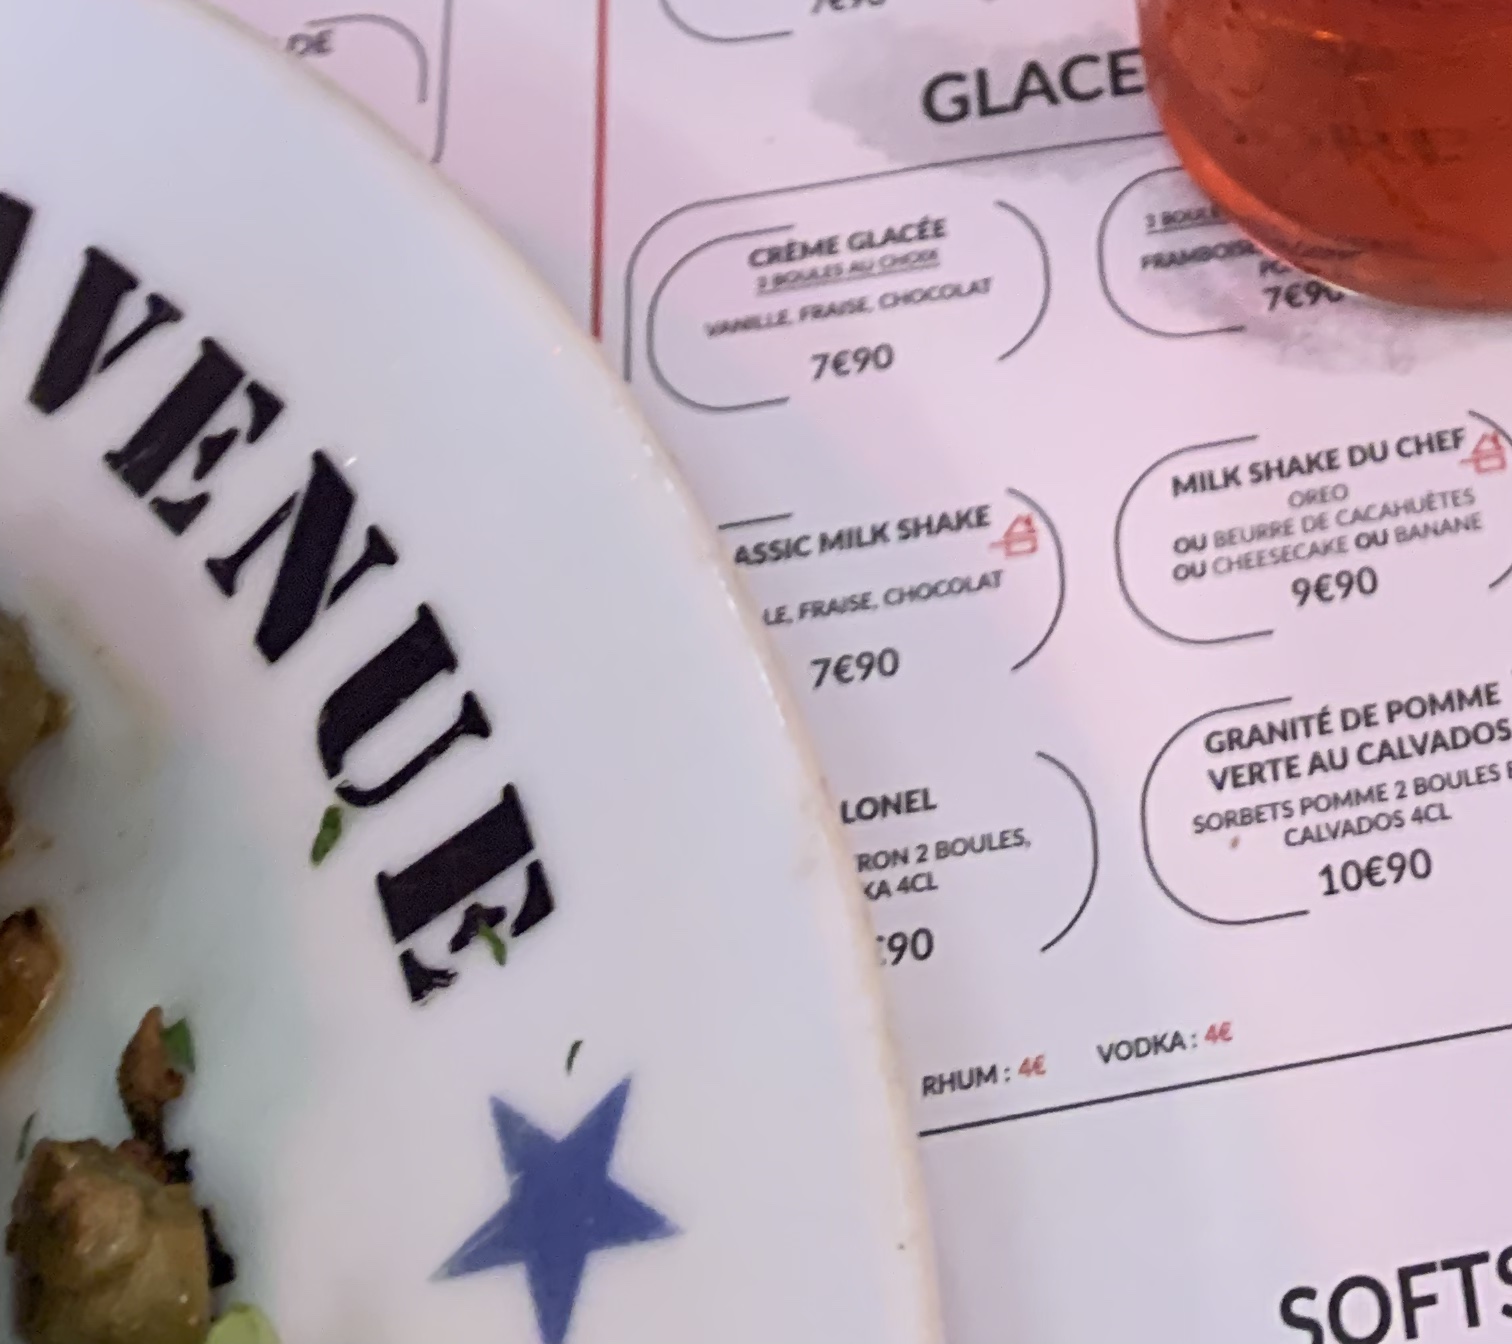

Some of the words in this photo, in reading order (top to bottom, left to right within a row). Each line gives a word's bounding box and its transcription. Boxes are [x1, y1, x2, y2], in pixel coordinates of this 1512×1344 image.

[921, 47, 1145, 124] GLACE
[748, 233, 839, 269] CRÈME
[846, 215, 948, 252] GLACÉE
[878, 275, 993, 310] CHOCOLAT
[809, 341, 895, 382] 7€90
[1171, 465, 1242, 499] MILK
[1248, 447, 1341, 486] SHAKE
[1348, 439, 1389, 468] DU
[1395, 426, 1467, 458] CHEF
[1287, 483, 1350, 510] OREO
[818, 521, 891, 554] MILK
[899, 504, 992, 540] SHAKE
[1172, 535, 1208, 556] OU
[1212, 518, 1294, 550] BEURRE
[1301, 511, 1329, 533] DE
[1334, 487, 1477, 527] CACAHUÈTES
[1172, 561, 1208, 583] OU
[1212, 536, 1349, 575] CHEESECAKE
[1354, 529, 1389, 552] OU
[1394, 512, 1483, 545] BANANE
[883, 569, 1004, 608] CHOCOLAT
[1290, 566, 1379, 608] 9€90
[810, 646, 901, 691] 7€90
[1203, 706, 1332, 755] GRANITÉ
[1340, 703, 1380, 732] DE
[1387, 681, 1502, 724] POMME
[1207, 755, 1300, 792] VERTE
[1307, 747, 1348, 777] AU
[840, 787, 938, 825] LONEL
[1192, 797, 1294, 835] SORBETS
[1300, 783, 1388, 819] POMME
[1394, 779, 1409, 800] 2
[1413, 763, 1502, 797] BOULES
[915, 843, 929, 863] 2
[935, 828, 1032, 860] BOULES,
[1284, 809, 1405, 847] CALVADOS
[1410, 802, 1452, 825] 4CL
[896, 871, 939, 895] 4CL
[1318, 847, 1433, 897] 10€90
[876, 927, 934, 967] 90
[921, 1064, 999, 1098] RHUM
[1017, 1054, 1047, 1077] 4€
[1096, 1030, 1187, 1065] VODKA
[1204, 1020, 1234, 1044] 4€
